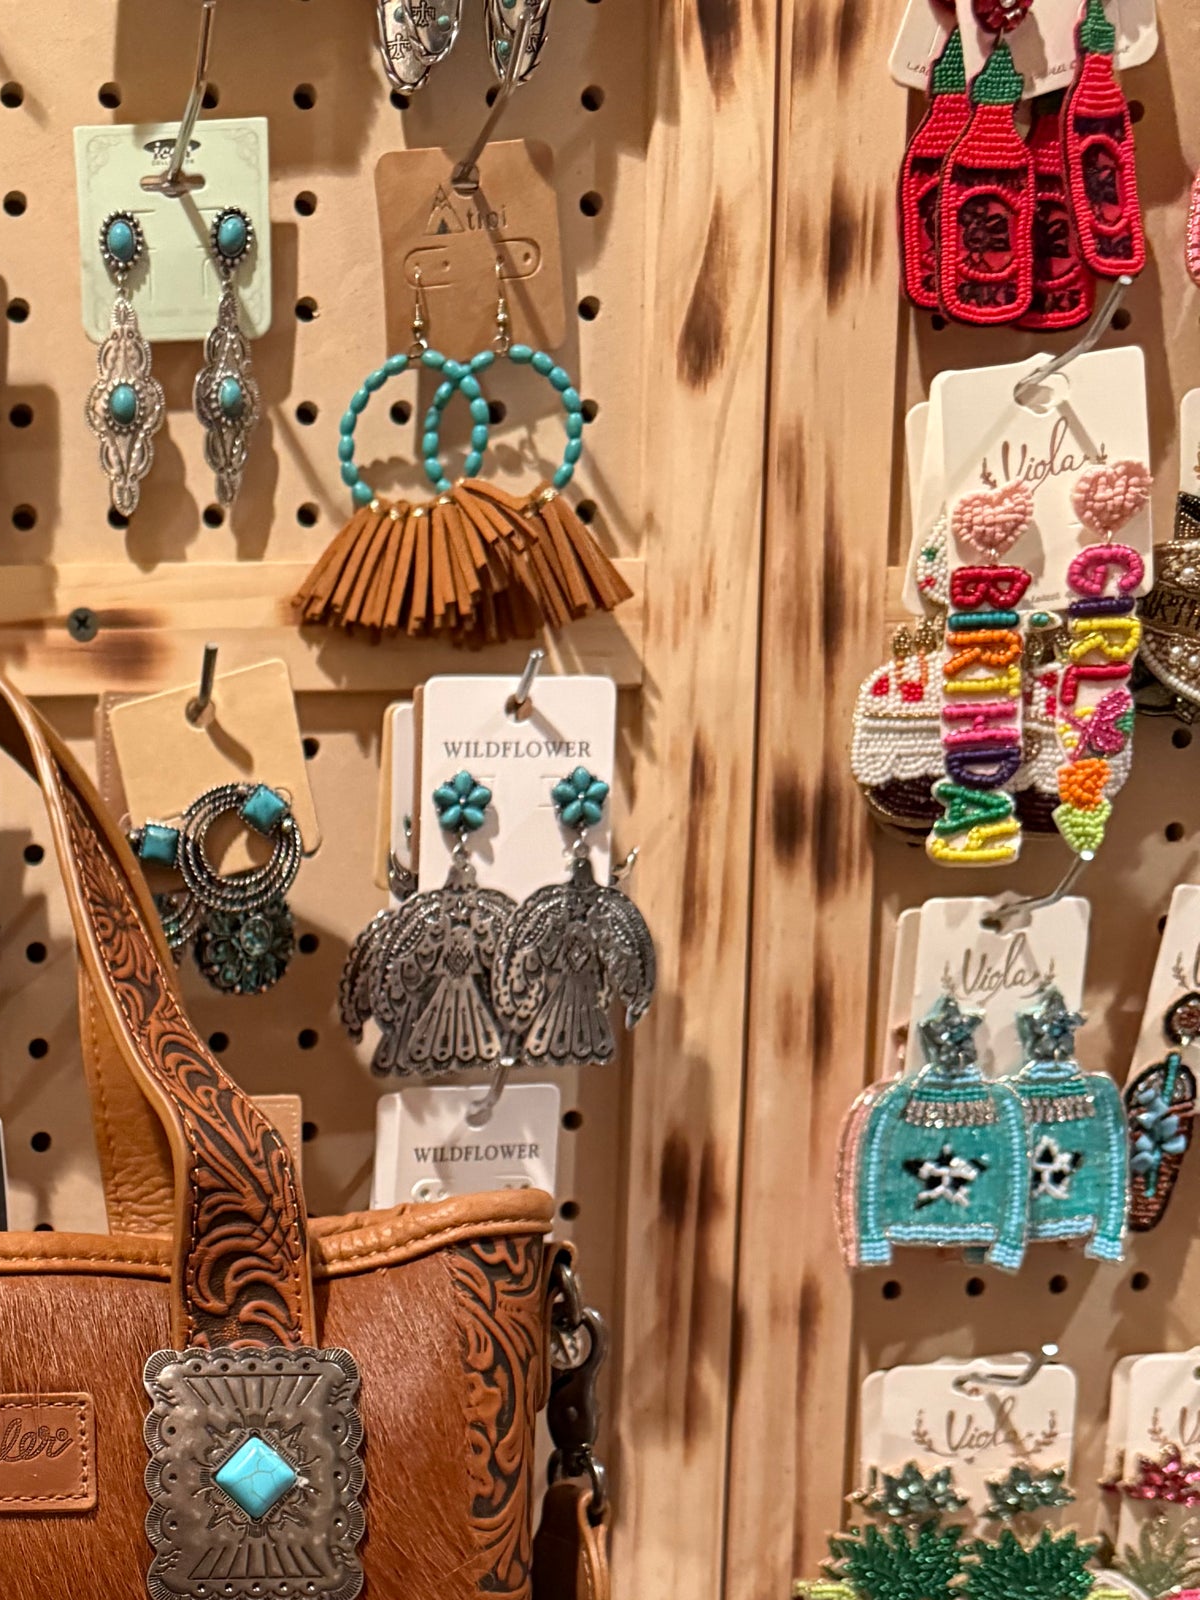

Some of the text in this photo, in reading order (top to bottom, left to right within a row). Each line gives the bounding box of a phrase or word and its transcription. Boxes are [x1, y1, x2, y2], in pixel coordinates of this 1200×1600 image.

[1002, 416, 1083, 483] Viola
[443, 741, 592, 759] WILDFLOWER
[962, 932, 1035, 996] Viola
[413, 1144, 540, 1163] WILDFLOWER
[946, 1395, 1020, 1453] Viola
